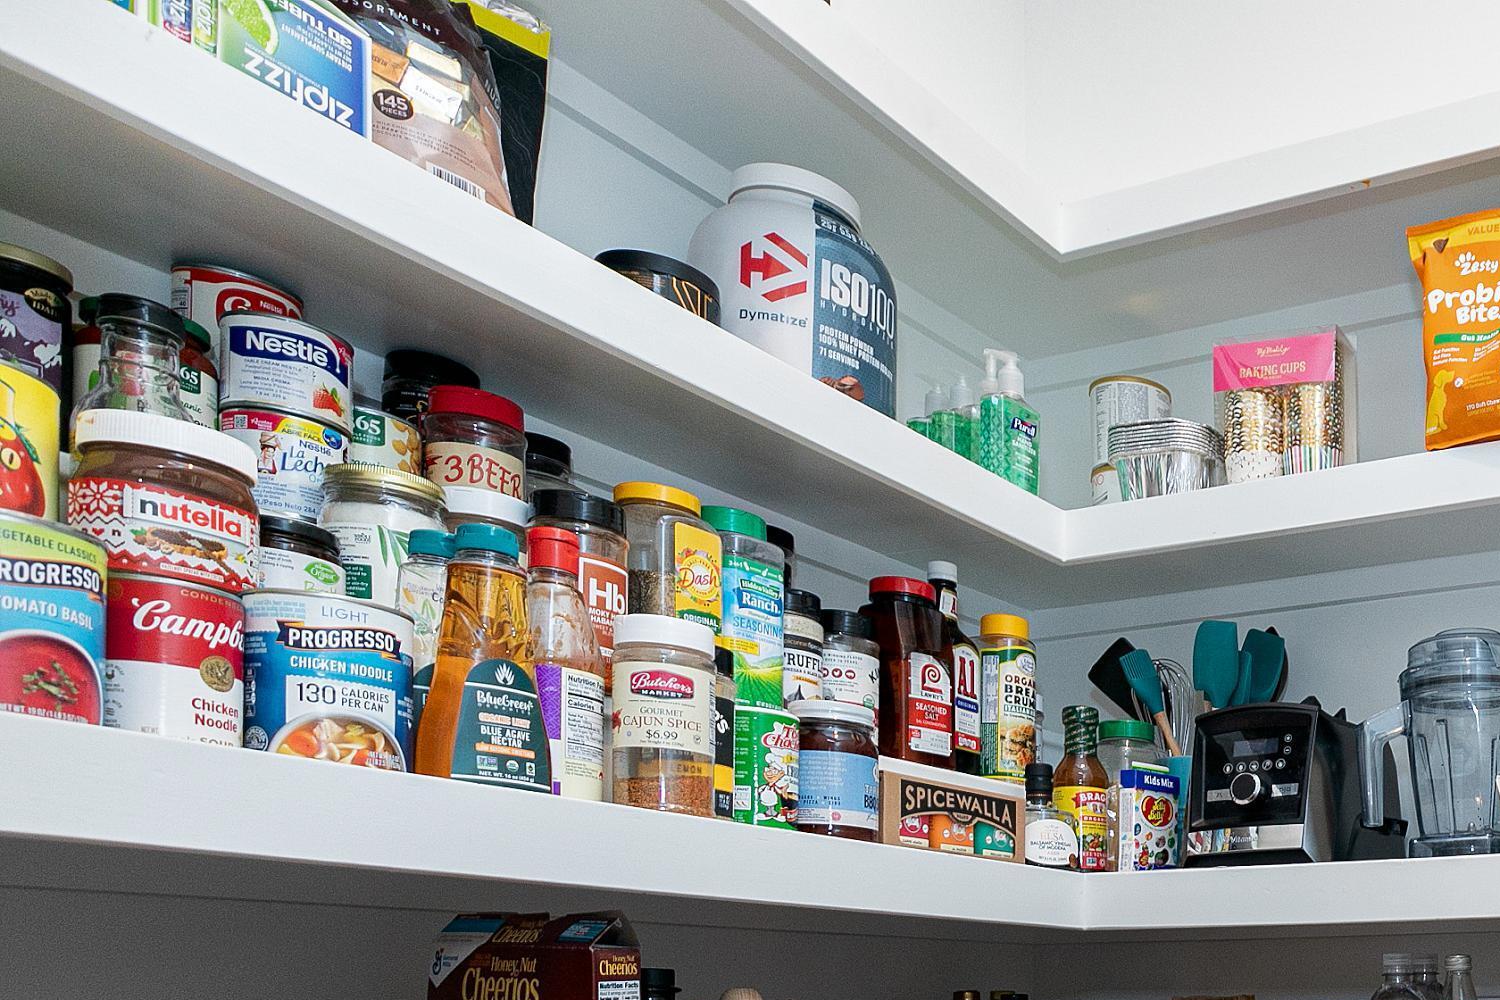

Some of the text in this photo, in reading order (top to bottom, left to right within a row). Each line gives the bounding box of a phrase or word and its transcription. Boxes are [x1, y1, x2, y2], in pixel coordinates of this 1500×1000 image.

[242, 47, 354, 129] zipfizz
[376, 93, 408, 109] 145
[1467, 223, 1500, 236] VALUE
[1460, 256, 1499, 275] Zesty
[820, 258, 895, 341] ISO100
[739, 308, 807, 329] Dymatize
[1240, 361, 1306, 379] BAKING CUPS
[467, 453, 521, 499] BEER
[140, 495, 242, 538] nutella
[57, 541, 98, 564] CLASSICS
[0, 558, 100, 593] ROGRESSO
[678, 569, 719, 589] Dash
[590, 575, 626, 615] Hb
[742, 592, 780, 612] Ranch
[62, 605, 94, 630] BASIL
[322, 606, 369, 624] LIGHT
[684, 614, 718, 628] ORIGINAL
[733, 616, 783, 639] SEASONING
[288, 628, 395, 652] PROGRESSO
[290, 655, 393, 682] CHICKEN NOODLE
[957, 655, 977, 699] A1
[630, 670, 693, 694] Butchers
[296, 682, 336, 705] 130
[341, 687, 390, 704] CALORIES
[640, 689, 685, 699] MARKET
[192, 698, 239, 718] Chicken
[639, 707, 683, 717] GOURMET
[915, 701, 947, 715] SEASONED
[194, 713, 238, 732] Noodle
[623, 715, 702, 732] CAJUN SPICE
[481, 726, 530, 742] BLUE AGAVE
[491, 737, 522, 748] NECTAR
[646, 730, 678, 741] $6.99
[906, 786, 1013, 824] SPICEWALLA
[491, 956, 515, 973] Honey
[600, 958, 638, 977] Cheerios
